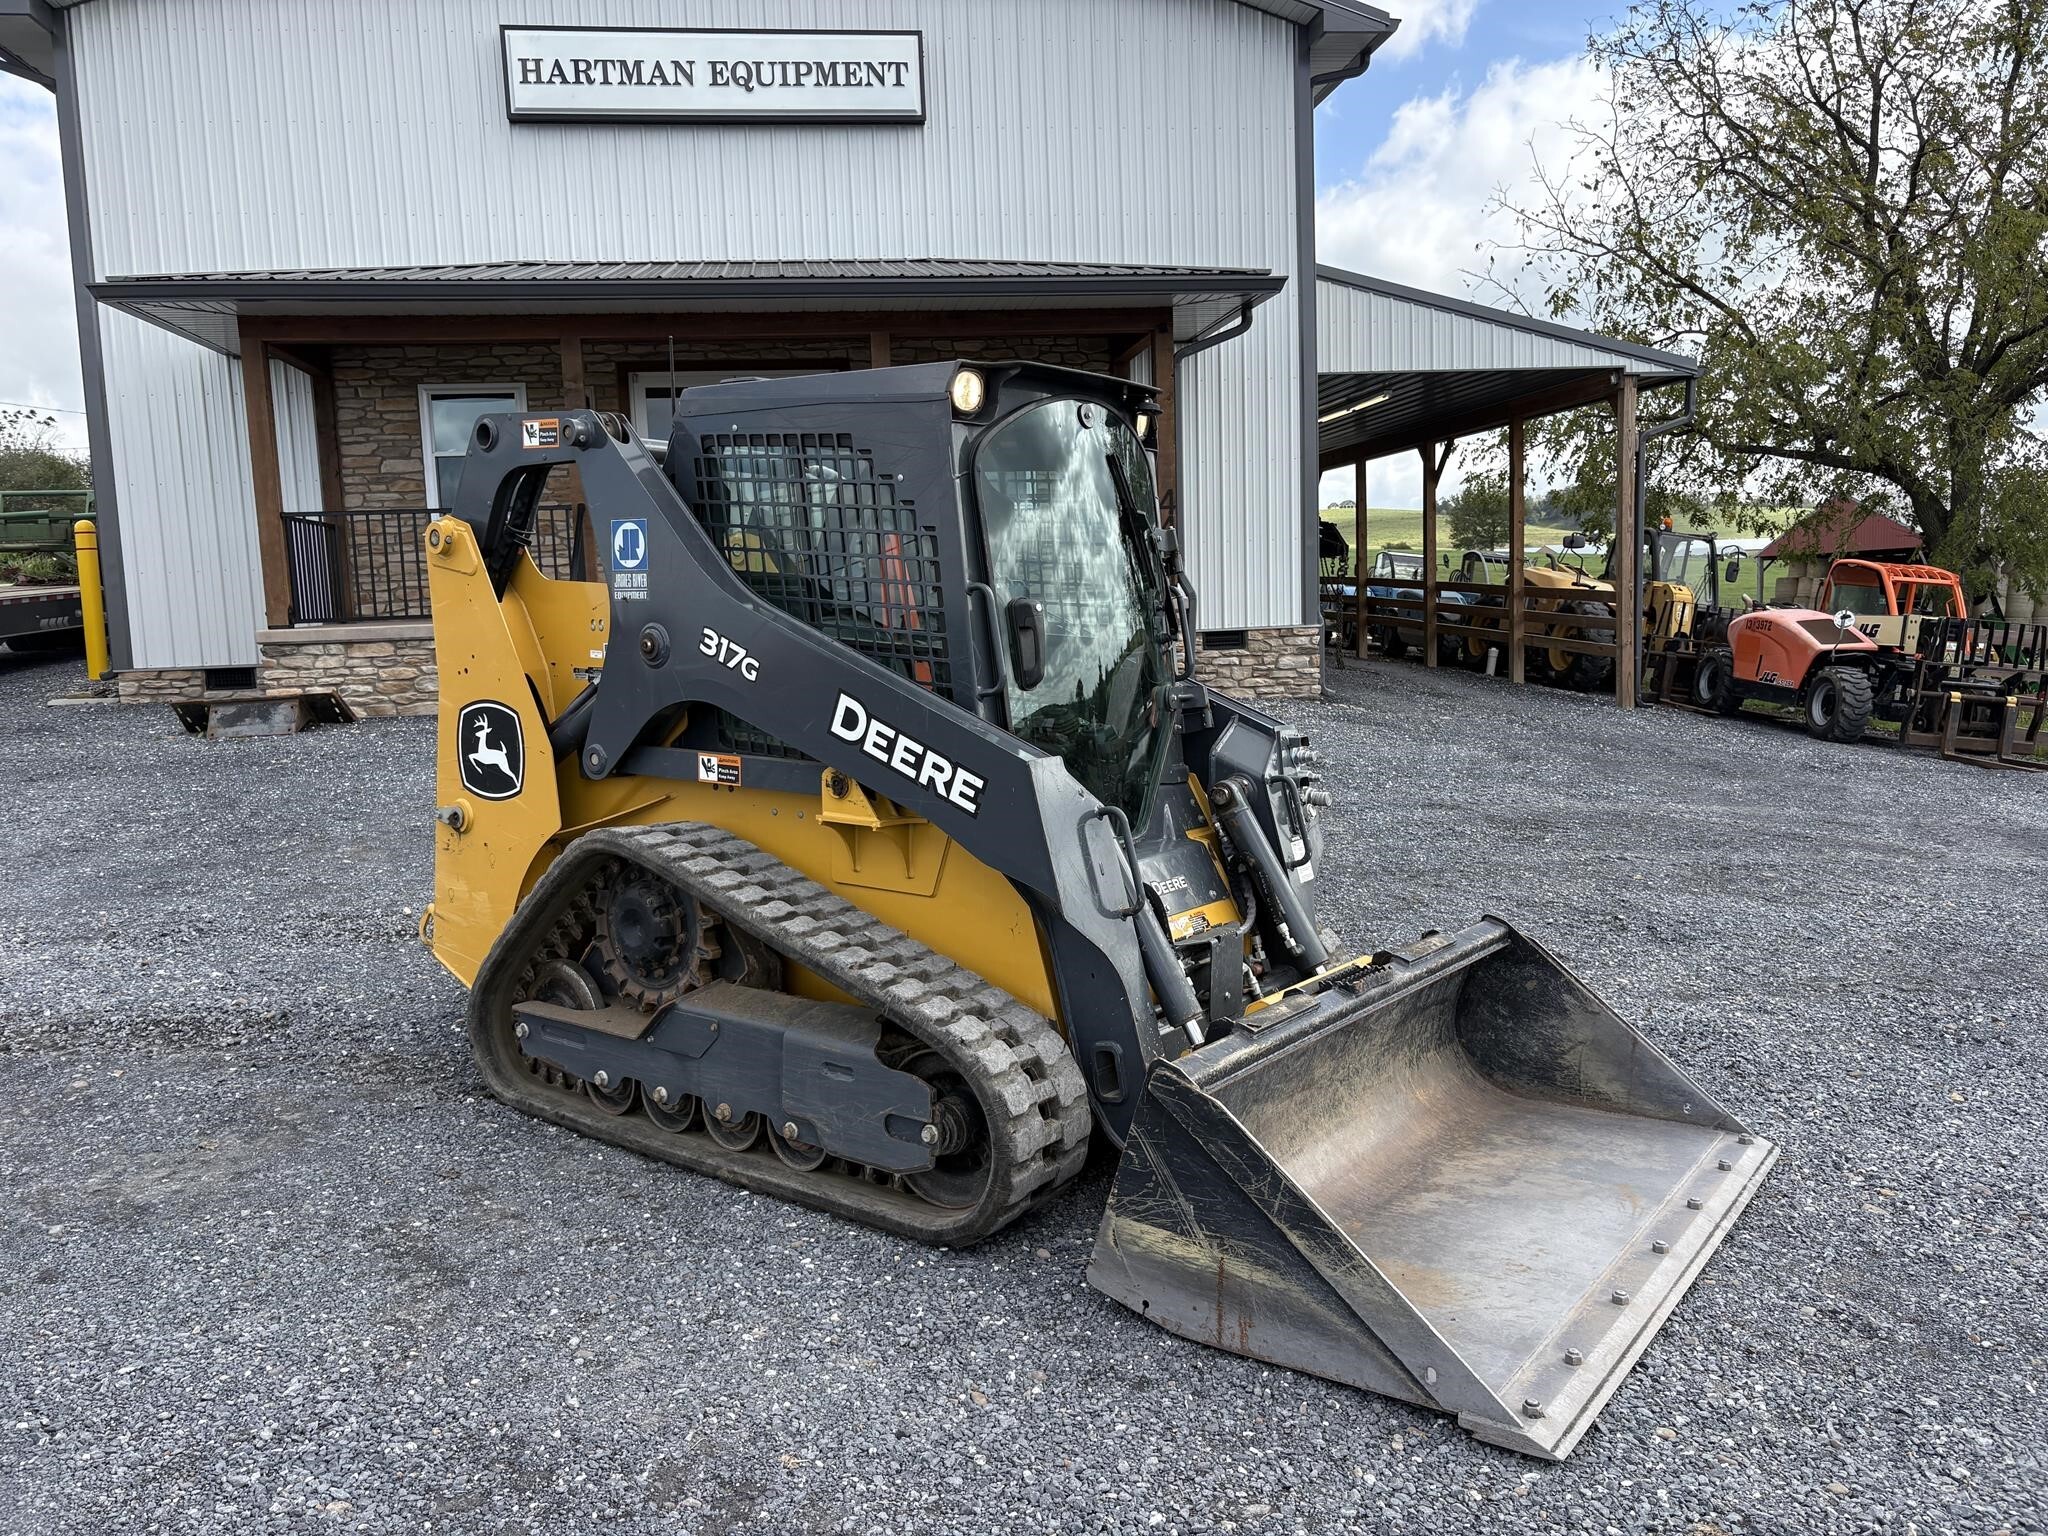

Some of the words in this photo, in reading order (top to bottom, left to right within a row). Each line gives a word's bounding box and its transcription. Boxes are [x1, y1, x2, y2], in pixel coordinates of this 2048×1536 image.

[517, 58, 695, 88] HARTMAN
[708, 60, 909, 92] EQUIPMENT
[614, 574, 632, 588] JAMES
[632, 574, 648, 588] RIVER
[614, 591, 648, 600] EQUIPMENT
[1859, 623, 1881, 638] JLG
[699, 627, 761, 682] 317G
[1758, 671, 1778, 684] JLG
[830, 693, 985, 814] DEERE
[1151, 876, 1188, 896] DEERE
